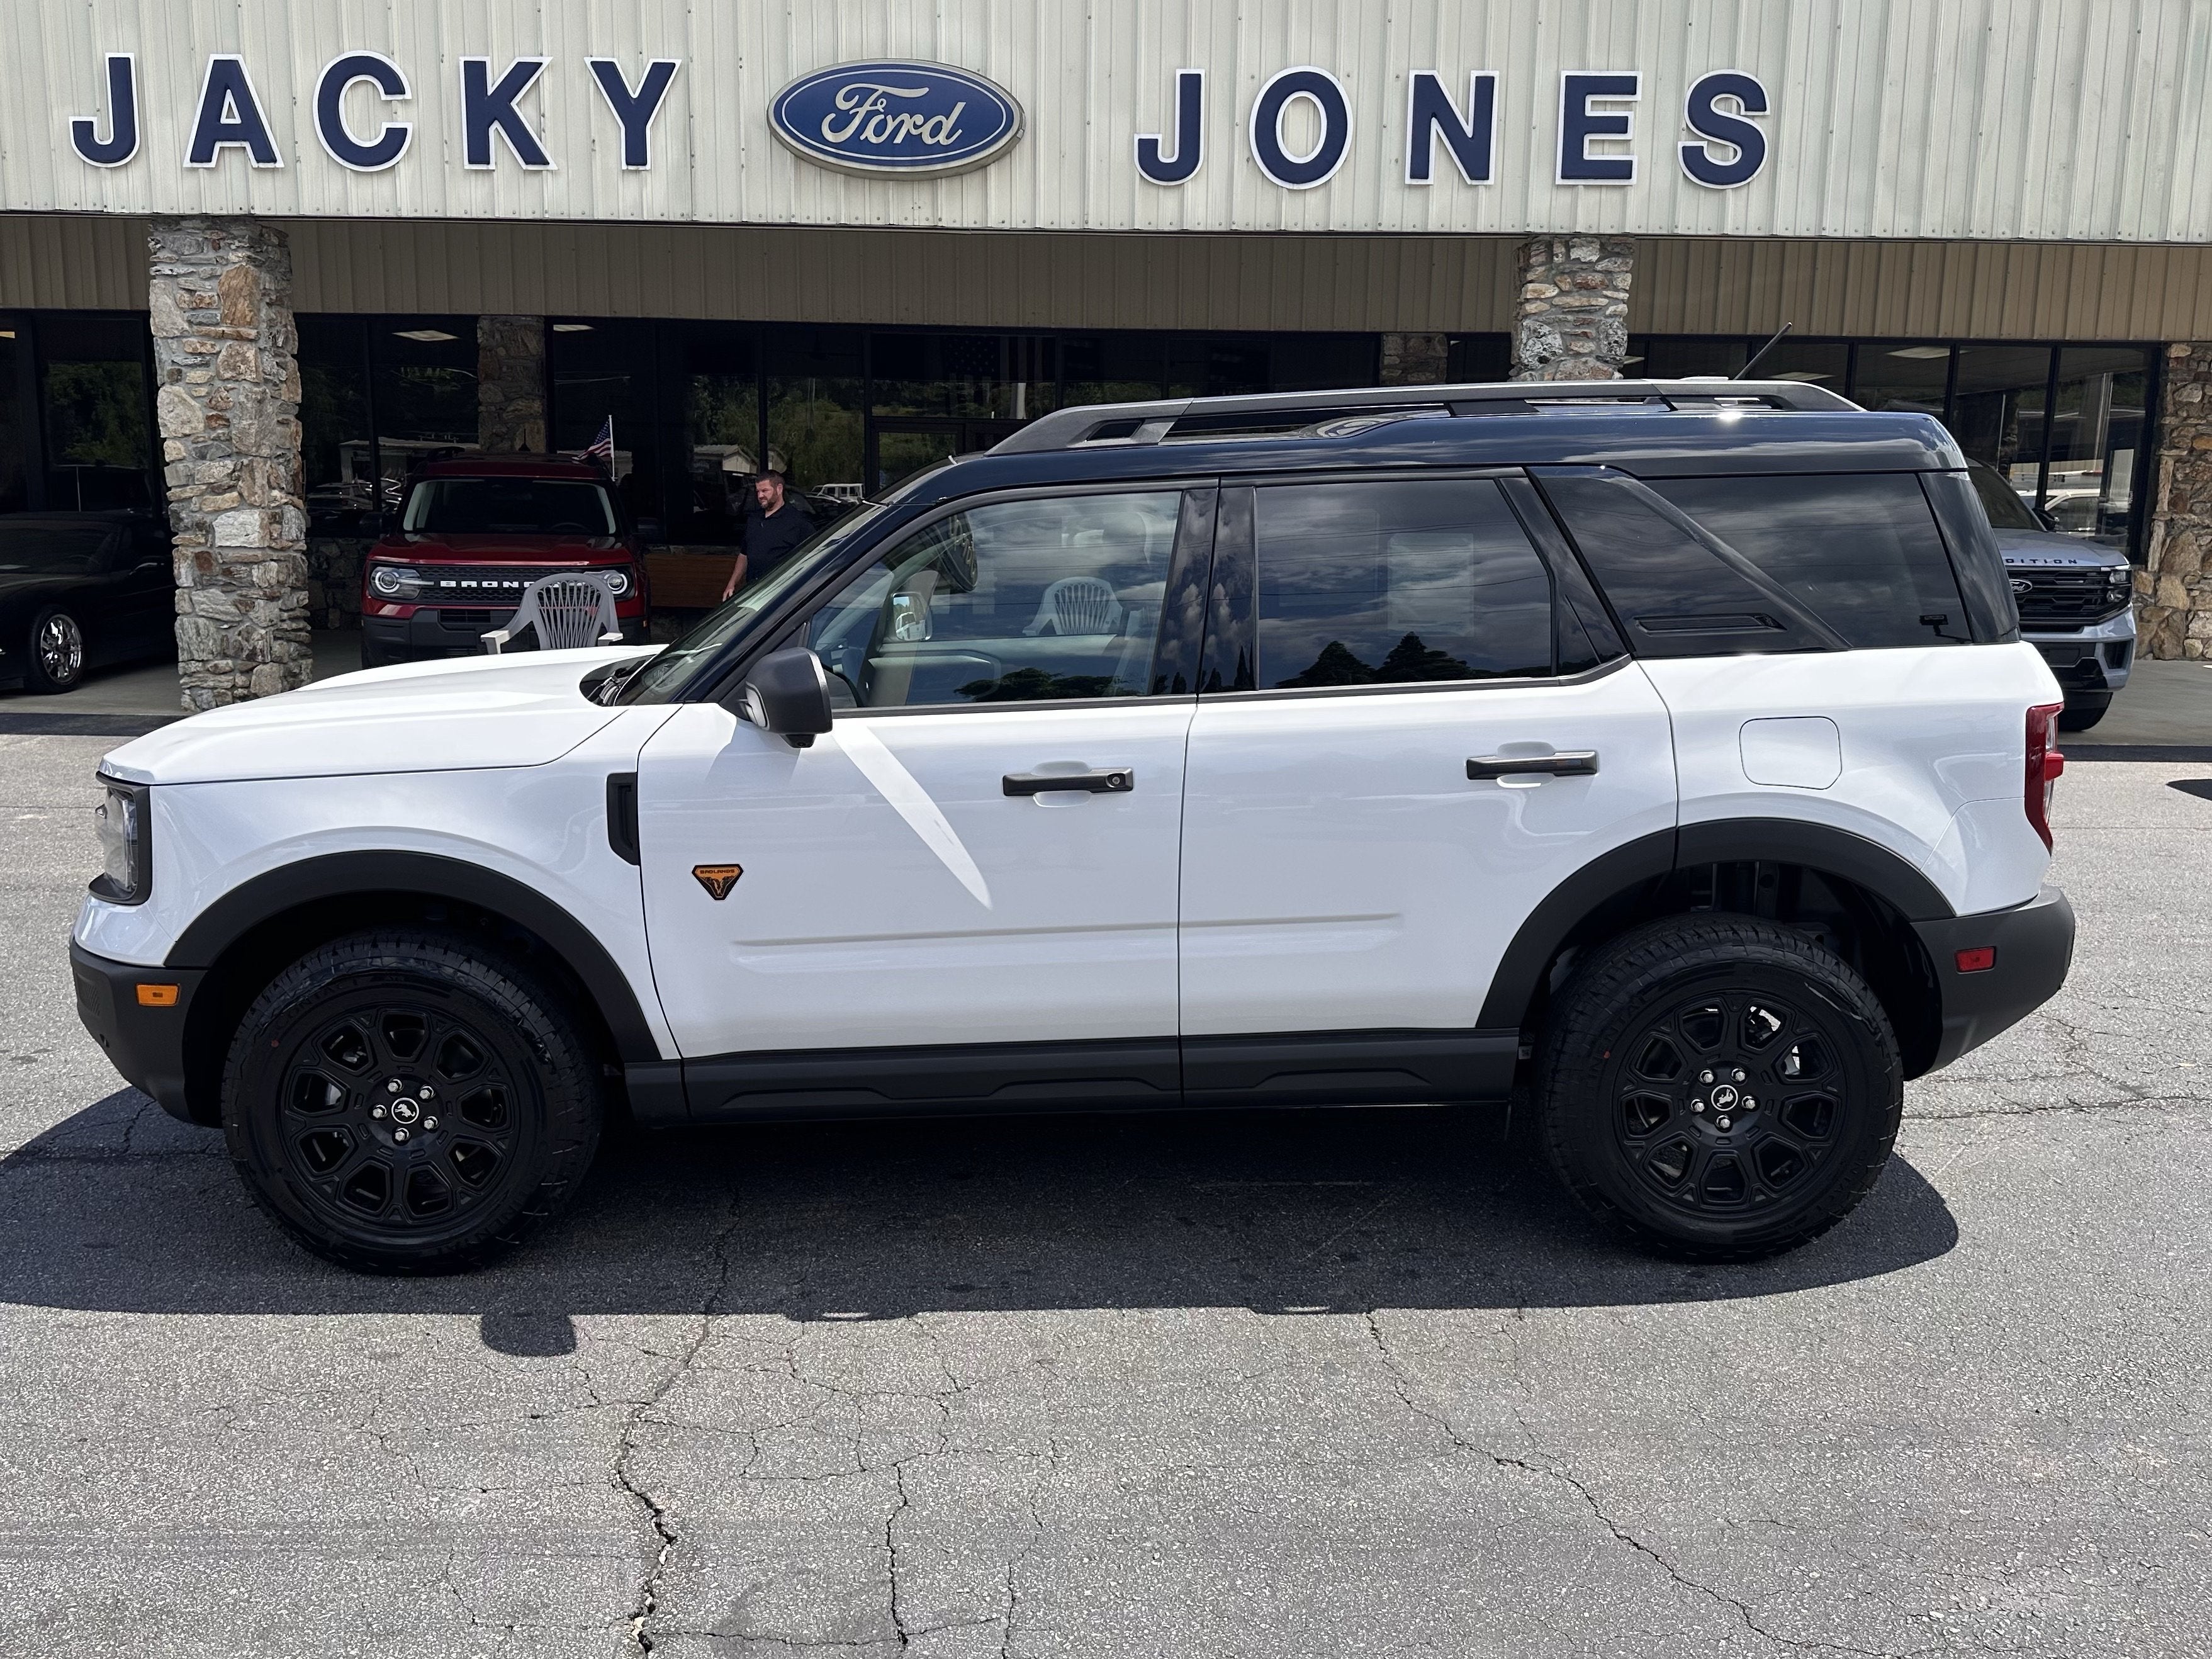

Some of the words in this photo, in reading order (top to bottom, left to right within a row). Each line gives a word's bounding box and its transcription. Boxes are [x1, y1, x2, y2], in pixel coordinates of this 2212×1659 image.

[69, 51, 682, 172] JACKY
[1133, 65, 1770, 190] JONES
[821, 83, 967, 145] Ford
[440, 580, 560, 588] BRONC
